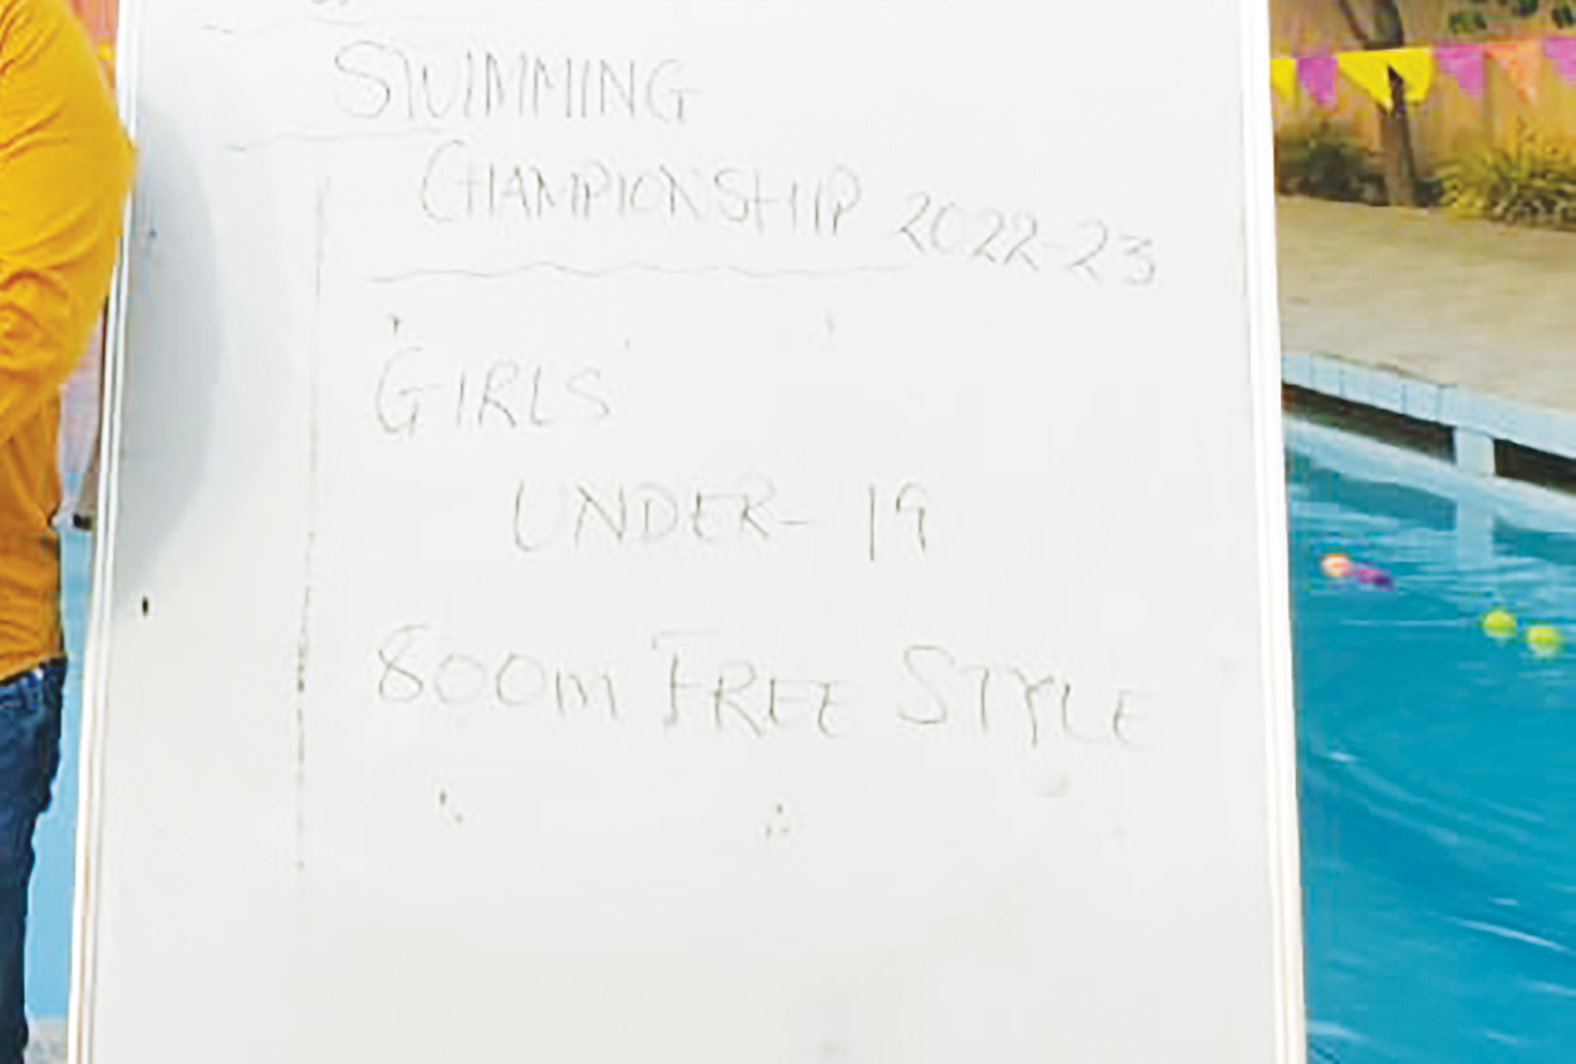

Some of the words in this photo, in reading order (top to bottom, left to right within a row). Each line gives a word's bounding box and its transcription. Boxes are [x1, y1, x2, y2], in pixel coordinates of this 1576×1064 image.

[333, 39, 704, 123] SWIMMING
[420, 140, 862, 236] CHAMPIONSHIP
[898, 190, 1157, 287] 2022-23
[654, 629, 850, 738] FREE
[897, 645, 1151, 747] STYLE
